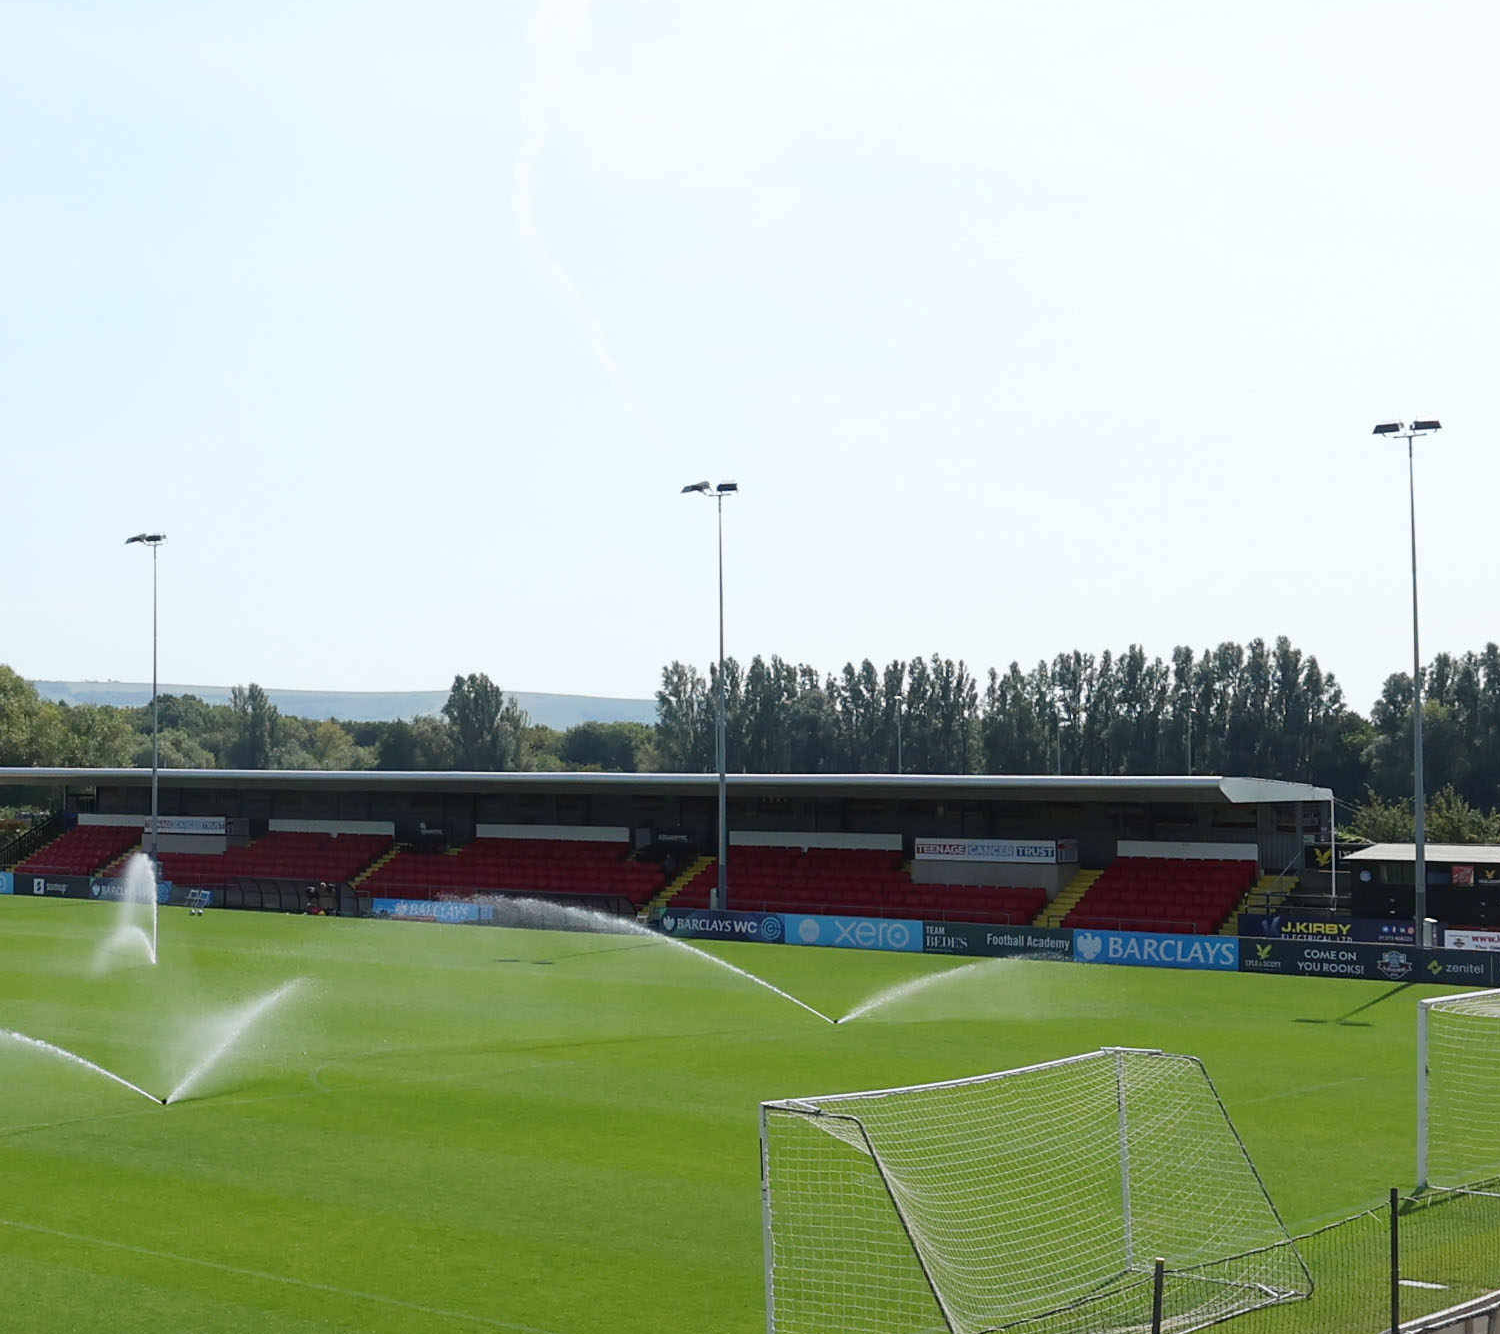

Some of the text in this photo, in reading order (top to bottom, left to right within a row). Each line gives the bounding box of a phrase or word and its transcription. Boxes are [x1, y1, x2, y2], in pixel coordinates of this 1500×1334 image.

[916, 843, 967, 856] TEENAGE
[1016, 845, 1056, 858] TRUST
[677, 917, 758, 934] BARCLAYS WC
[926, 925, 945, 935] TEAM
[1281, 921, 1352, 935] J.KIRBY
[835, 919, 910, 948] xero
[986, 932, 1071, 951] Football Academy
[1108, 937, 1235, 965] BARCLAYS
[1303, 949, 1357, 961] COME ON
[1297, 961, 1365, 974] YOU ROOKS!
[1446, 962, 1485, 974] zenitel
